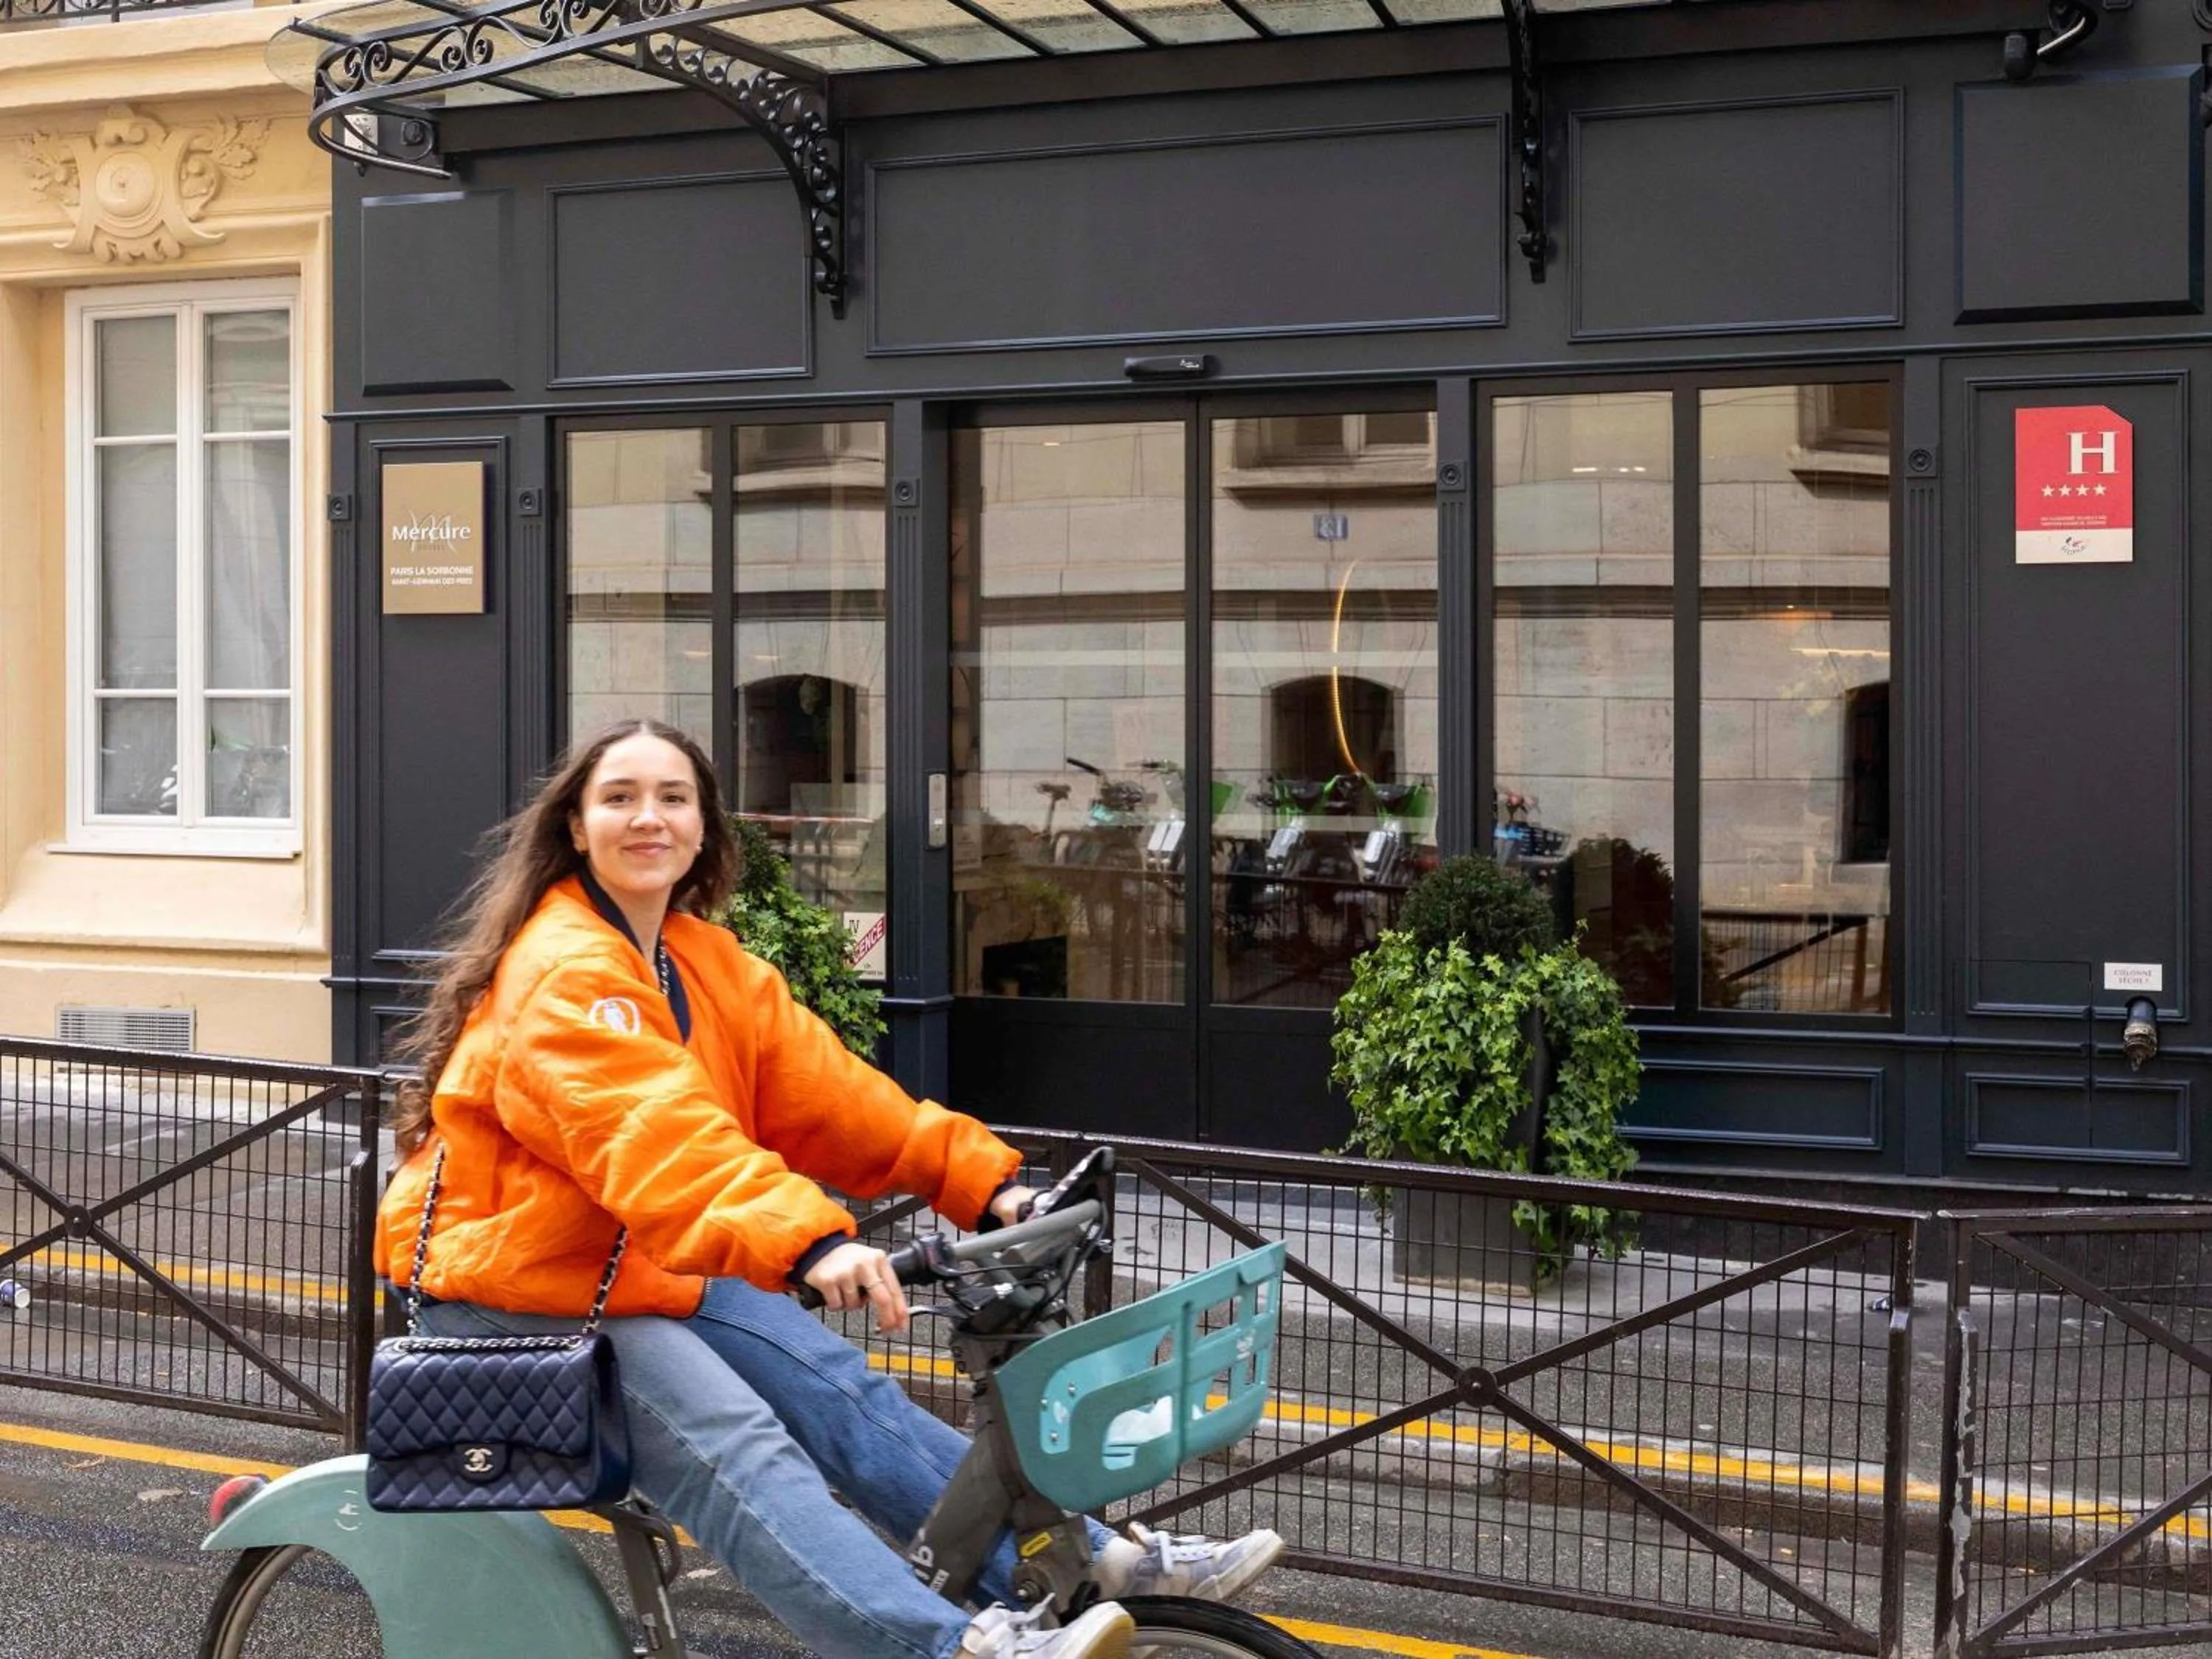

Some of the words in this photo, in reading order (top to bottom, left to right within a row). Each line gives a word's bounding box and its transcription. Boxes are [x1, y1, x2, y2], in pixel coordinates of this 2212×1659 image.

[2066, 431, 2121, 475] H
[392, 525, 471, 540] Mercure
[390, 567, 414, 576] PARIS
[416, 566, 425, 576] LA
[427, 566, 473, 576] SORBONNE
